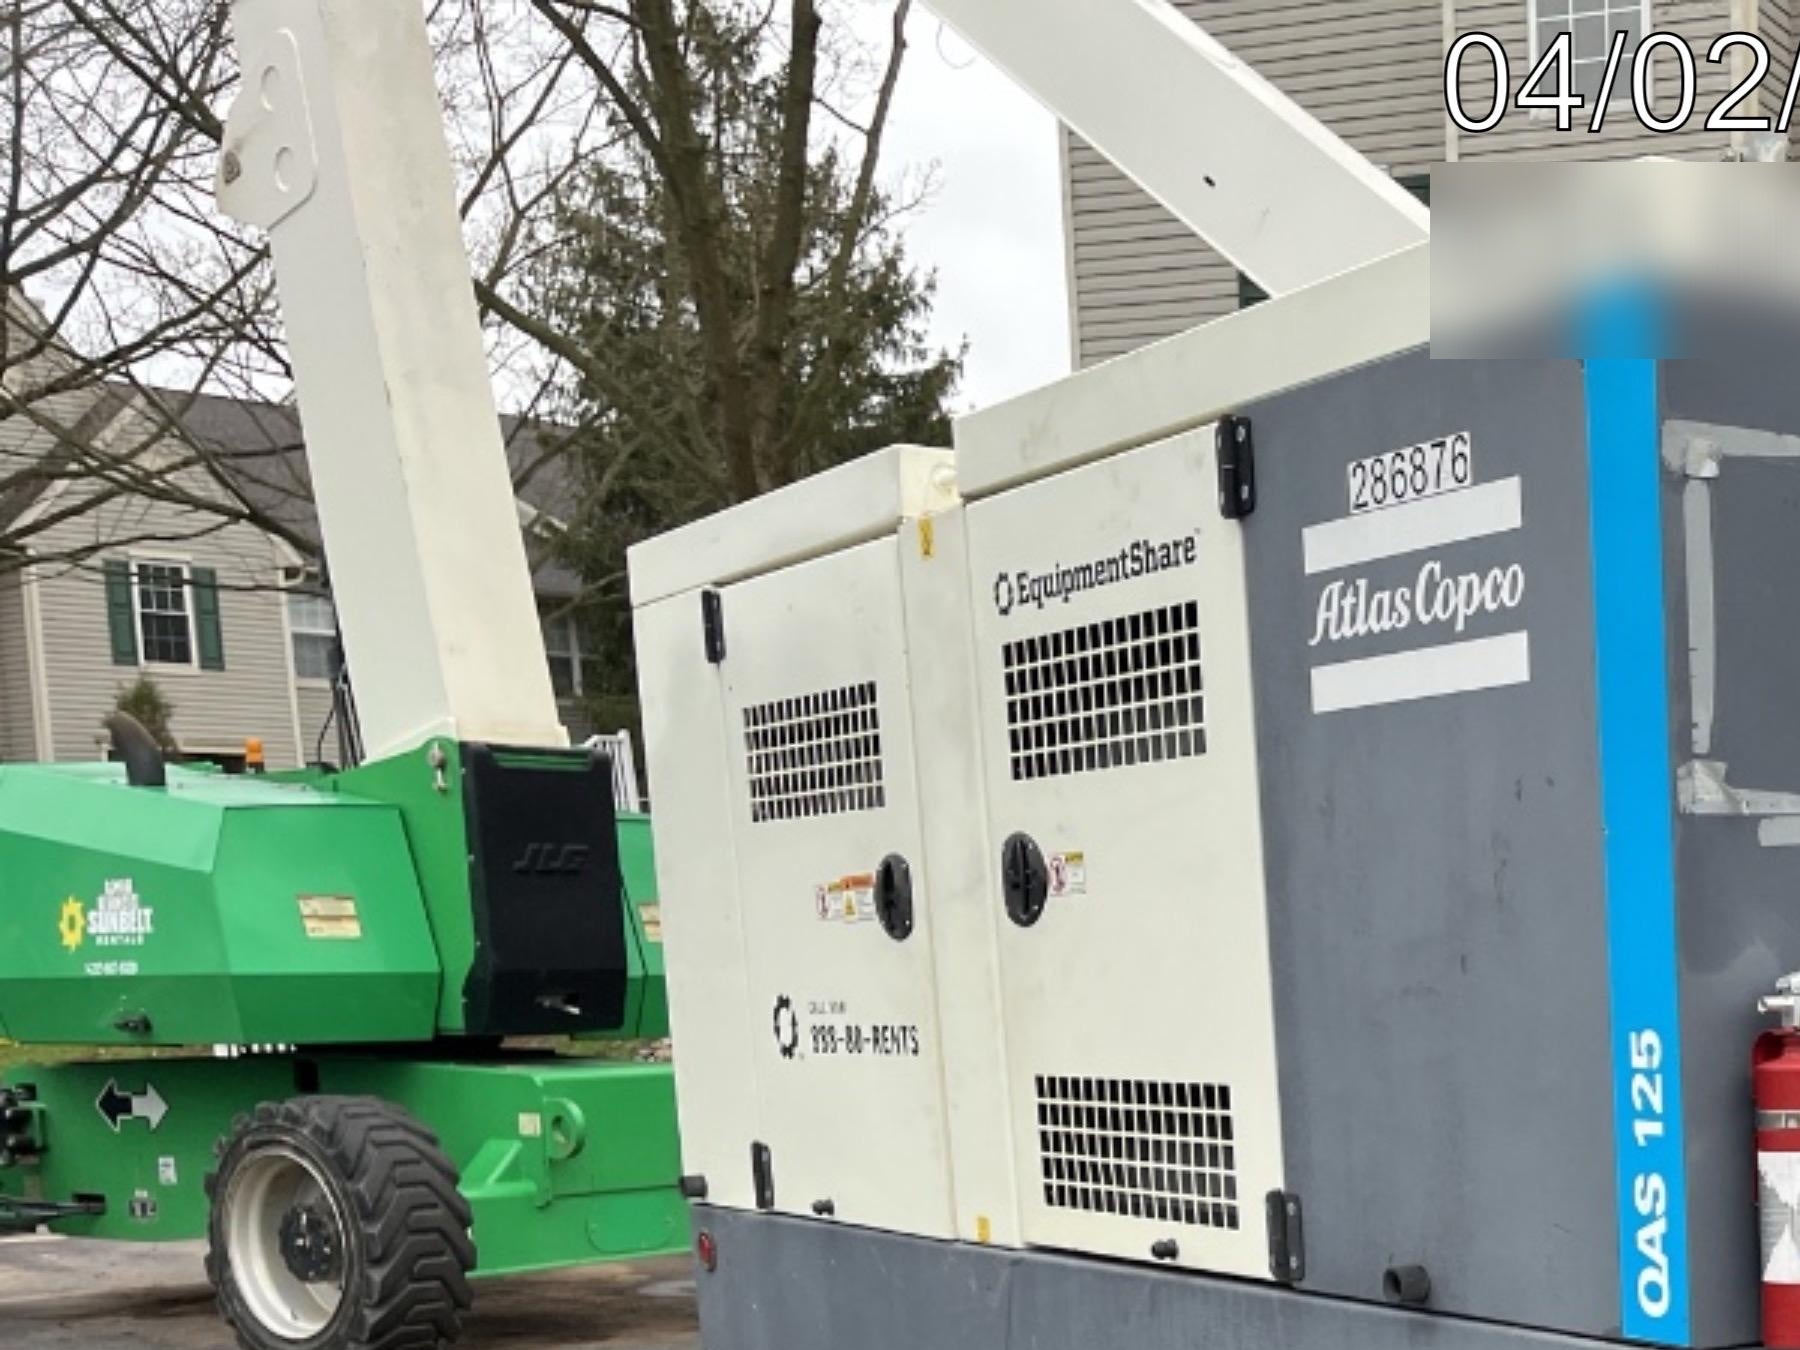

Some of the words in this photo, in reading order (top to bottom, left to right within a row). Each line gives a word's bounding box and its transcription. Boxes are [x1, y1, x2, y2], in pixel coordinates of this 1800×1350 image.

[1351, 433, 1469, 511] 286876
[1015, 535, 1196, 610] EquipmentShare
[1307, 577, 1412, 647] Atlas
[1415, 559, 1525, 633] Copco
[1628, 1027, 1665, 1147] 125
[1632, 1171, 1671, 1319] QAS
